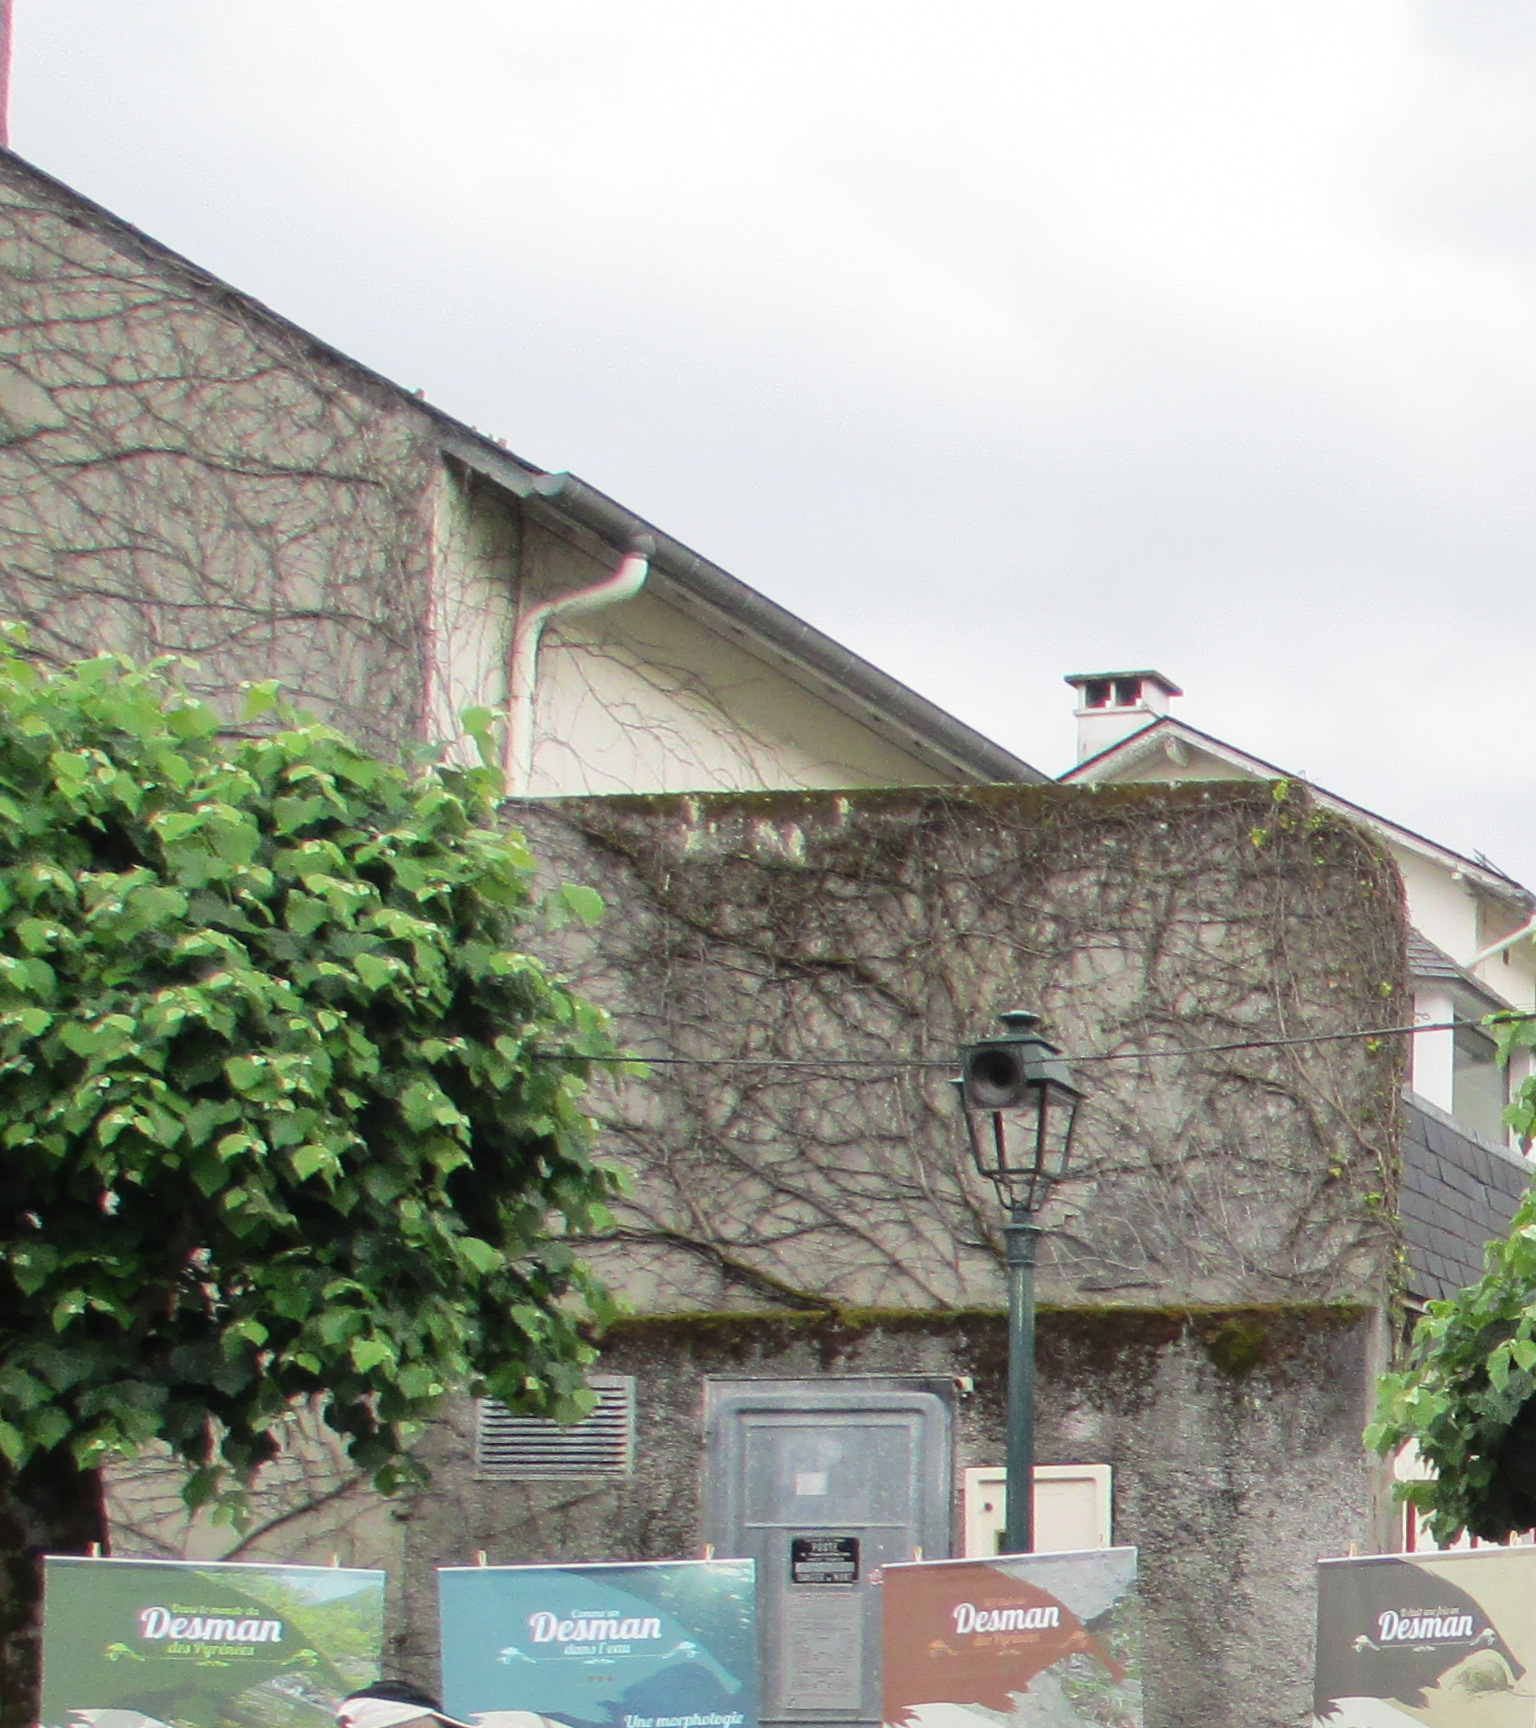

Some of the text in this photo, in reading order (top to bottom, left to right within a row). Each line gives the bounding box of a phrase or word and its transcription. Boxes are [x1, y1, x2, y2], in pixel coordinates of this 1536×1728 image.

[137, 1606, 283, 1643] Desman
[529, 1611, 663, 1643] Desman
[953, 1602, 1061, 1634] Desman
[1378, 1610, 1474, 1641] Desman
[624, 1714, 653, 1728] Une
